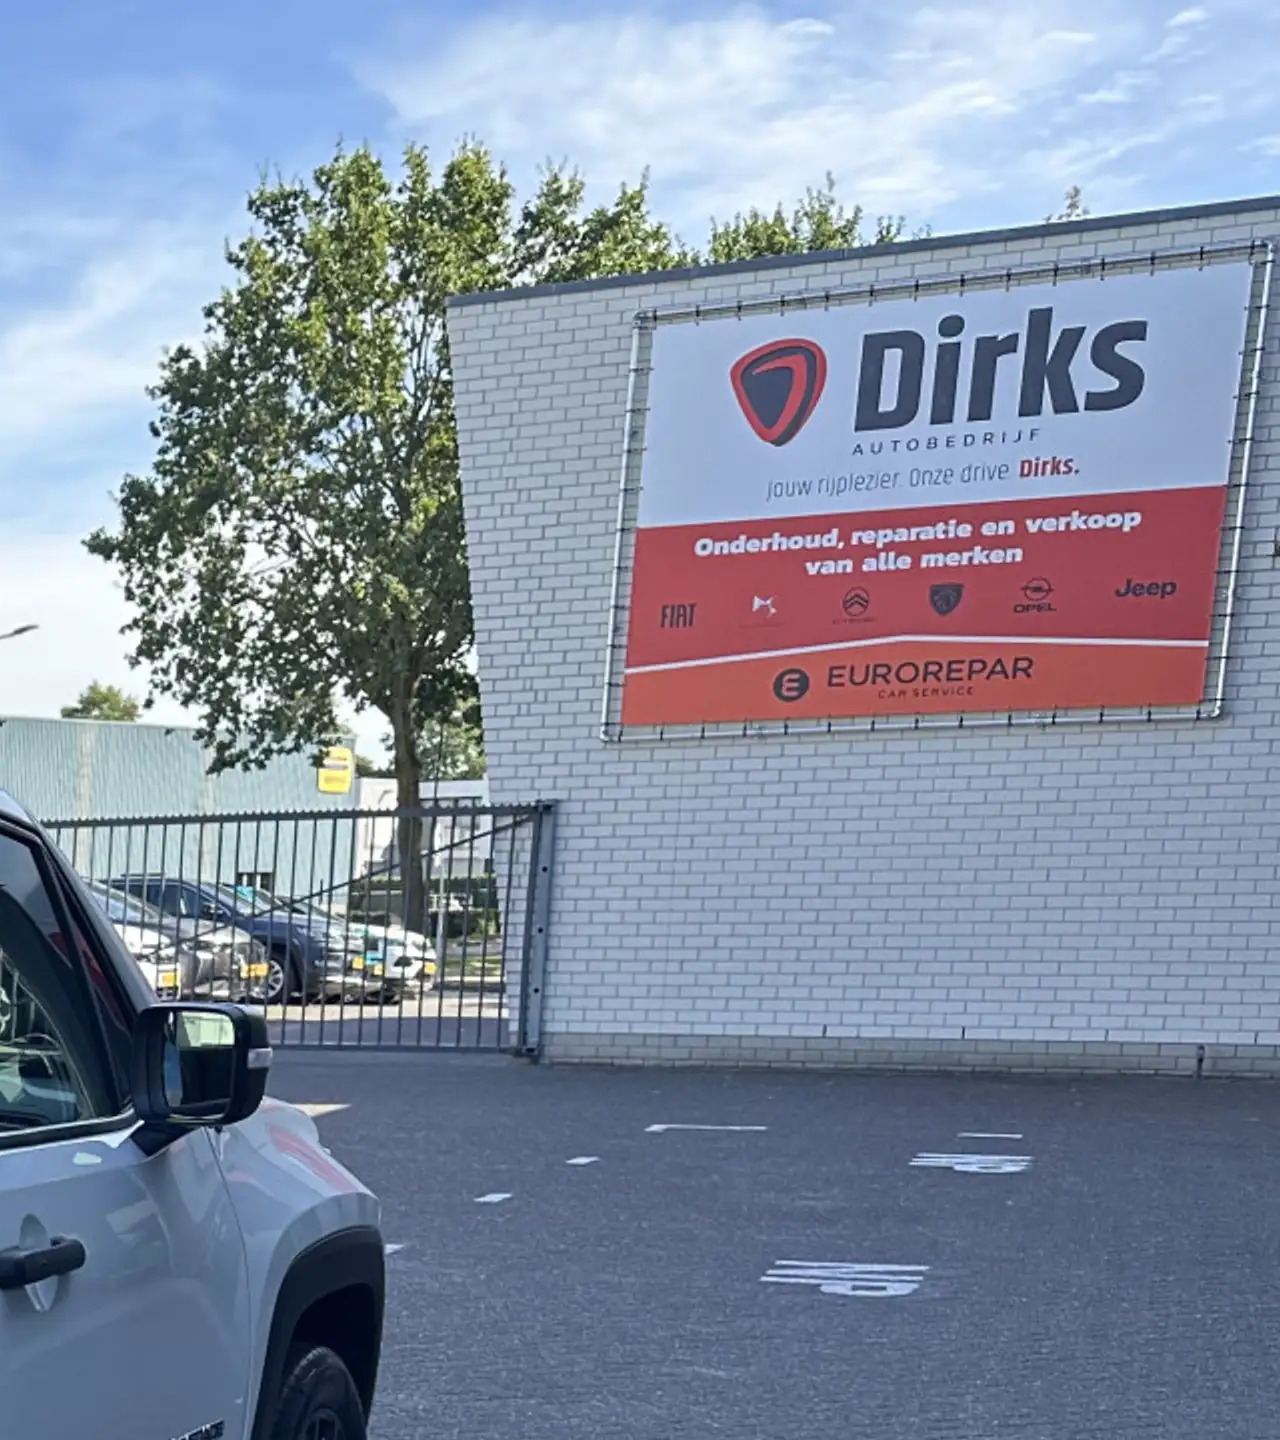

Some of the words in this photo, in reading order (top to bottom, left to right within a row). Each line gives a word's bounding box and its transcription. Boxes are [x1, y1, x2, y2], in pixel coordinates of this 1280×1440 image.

[853, 306, 1148, 432] Dirks
[851, 428, 1042, 457] AUTOBEDRIJF
[909, 465, 954, 487] Onze
[960, 461, 1009, 484] drive
[1019, 456, 1080, 479] Dirks.
[694, 527, 845, 556] Onderhoud,
[851, 518, 974, 549] reparatie
[980, 519, 1016, 536] en
[1025, 509, 1142, 534] verkoop
[805, 557, 854, 576] van
[862, 550, 912, 573] alle
[920, 544, 1023, 569] merken
[1114, 577, 1178, 600] Jeep
[659, 602, 697, 629] FIAT
[1013, 602, 1057, 614] OPEL
[827, 655, 1035, 688] EUROREPAR
[878, 688, 907, 699] CAR
[913, 686, 974, 698] SERVICE
